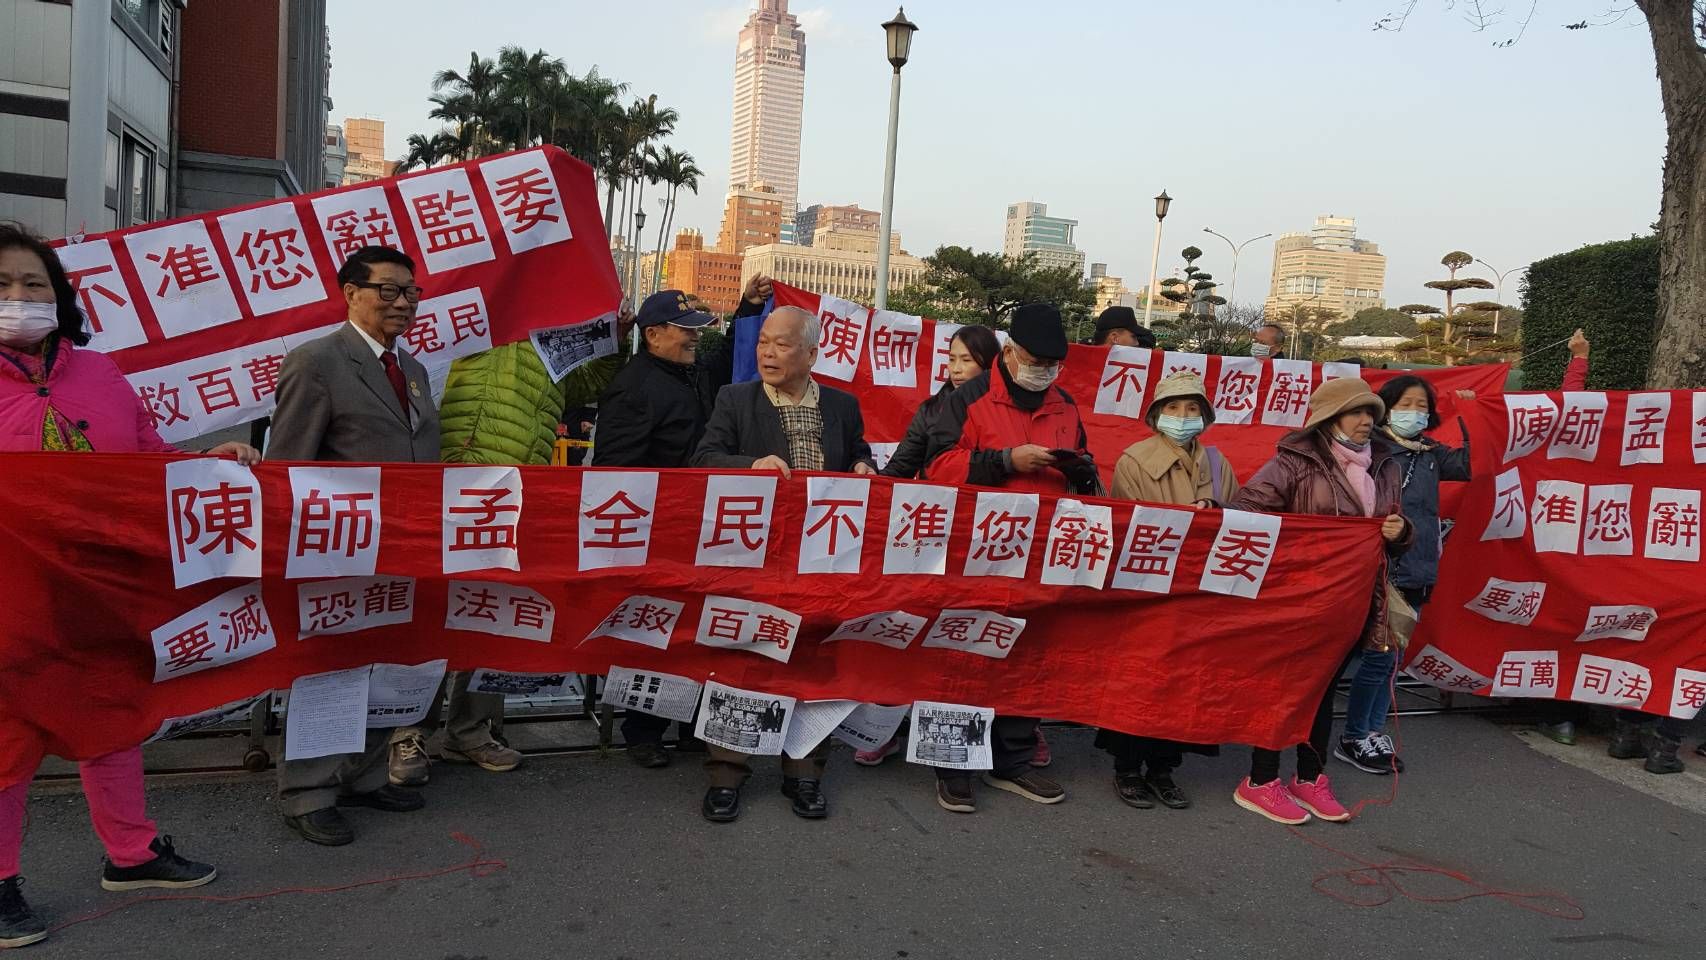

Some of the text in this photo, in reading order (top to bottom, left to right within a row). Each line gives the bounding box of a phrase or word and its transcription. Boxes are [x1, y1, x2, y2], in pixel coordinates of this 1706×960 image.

[1509, 405, 1706, 452] 陳師孟
[171, 482, 1271, 582] 陳師孟全民不准您辭監委
[1496, 484, 1698, 548] 不准您辭
